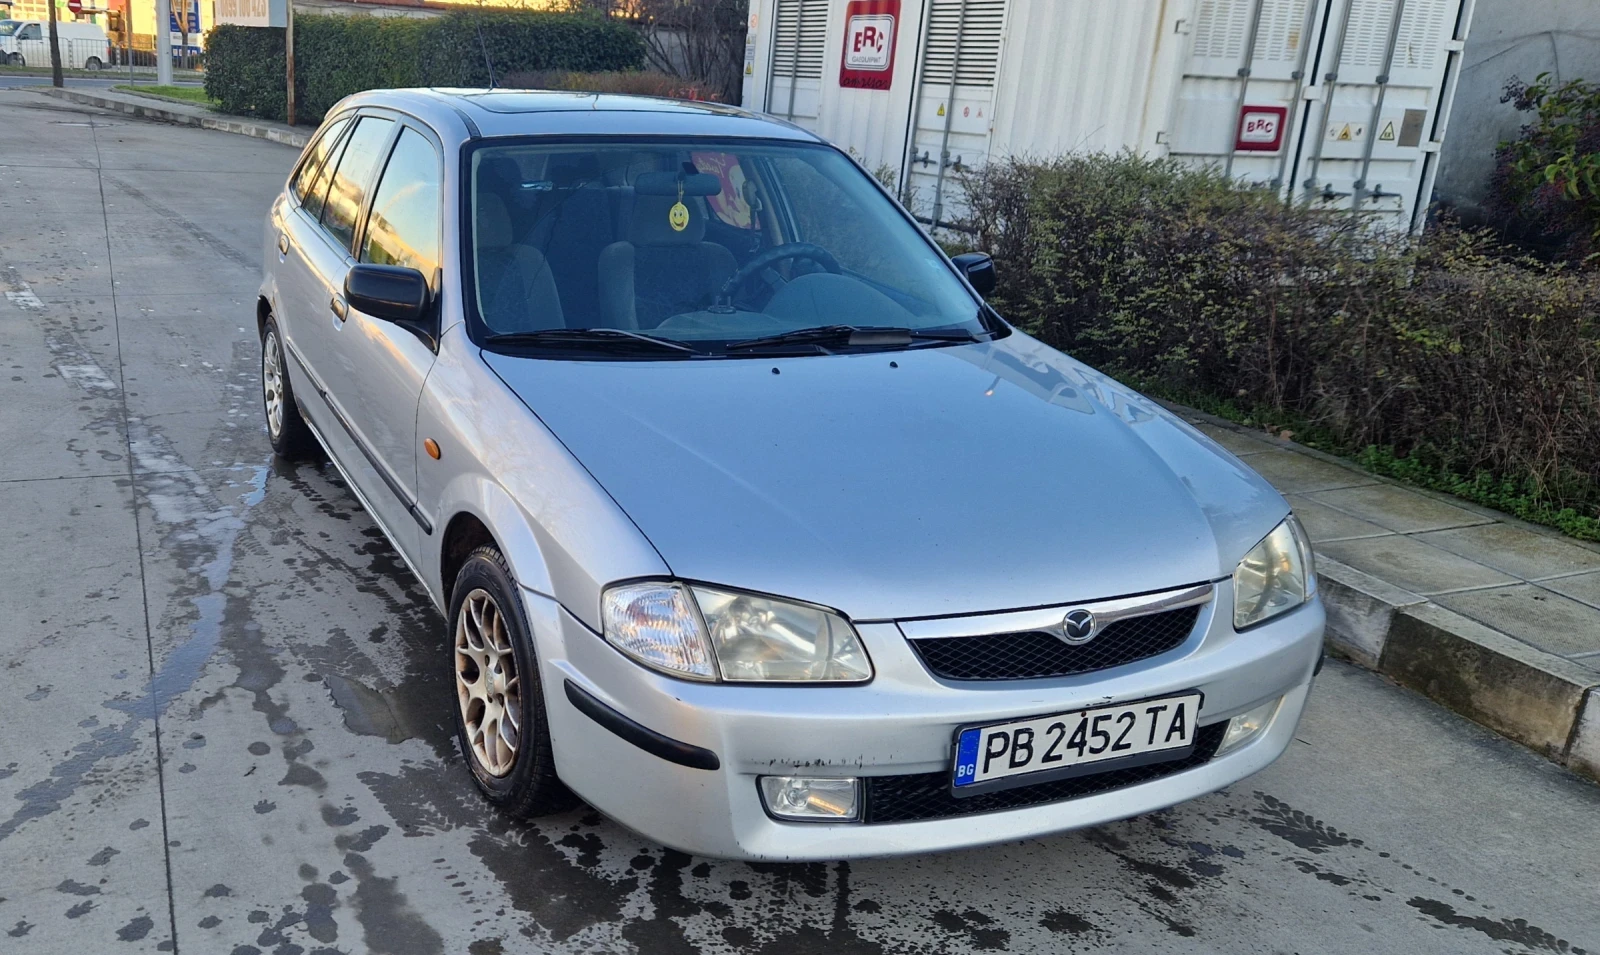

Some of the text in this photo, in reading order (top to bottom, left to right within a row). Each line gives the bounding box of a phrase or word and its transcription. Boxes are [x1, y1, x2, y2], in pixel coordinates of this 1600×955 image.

[1247, 119, 1274, 133] BRC
[983, 702, 1186, 774] PB 2452 TA
[957, 763, 974, 778] BG
